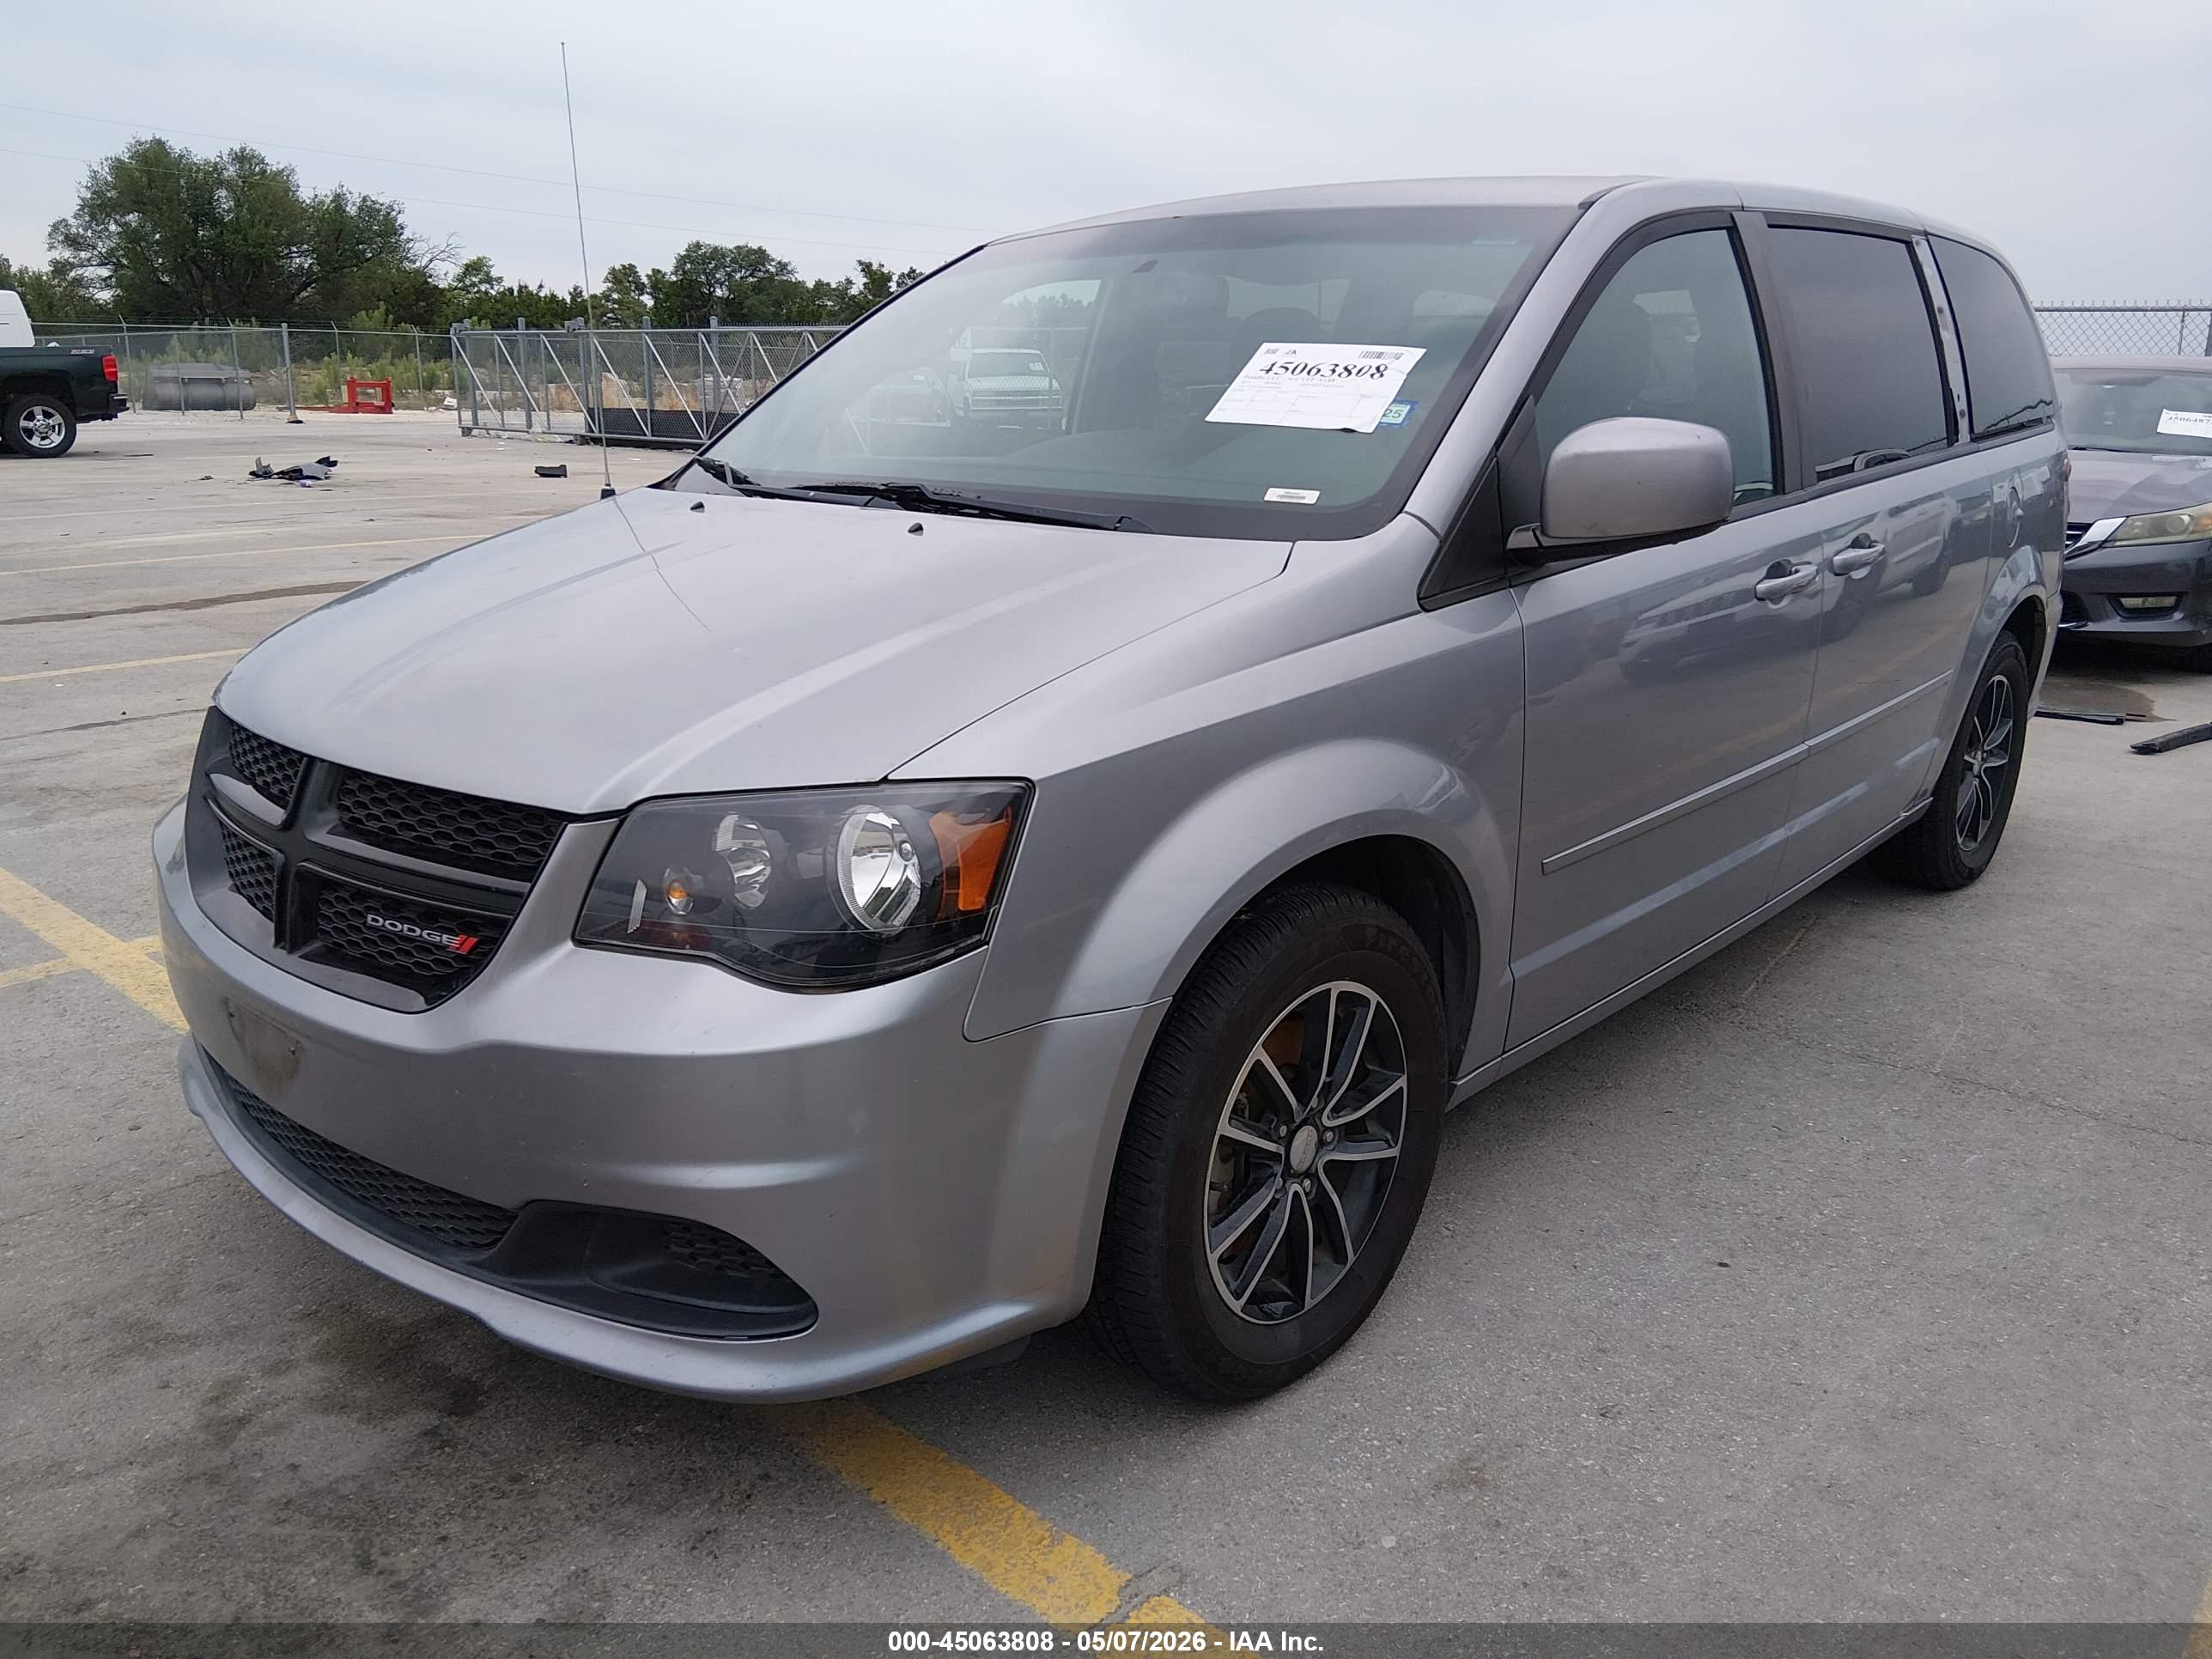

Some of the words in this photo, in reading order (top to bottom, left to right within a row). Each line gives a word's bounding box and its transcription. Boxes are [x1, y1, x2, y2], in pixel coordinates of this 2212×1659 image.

[1259, 361, 1389, 380] 45063808
[1382, 408, 1403, 418] 25
[366, 914, 461, 948] DODGE
